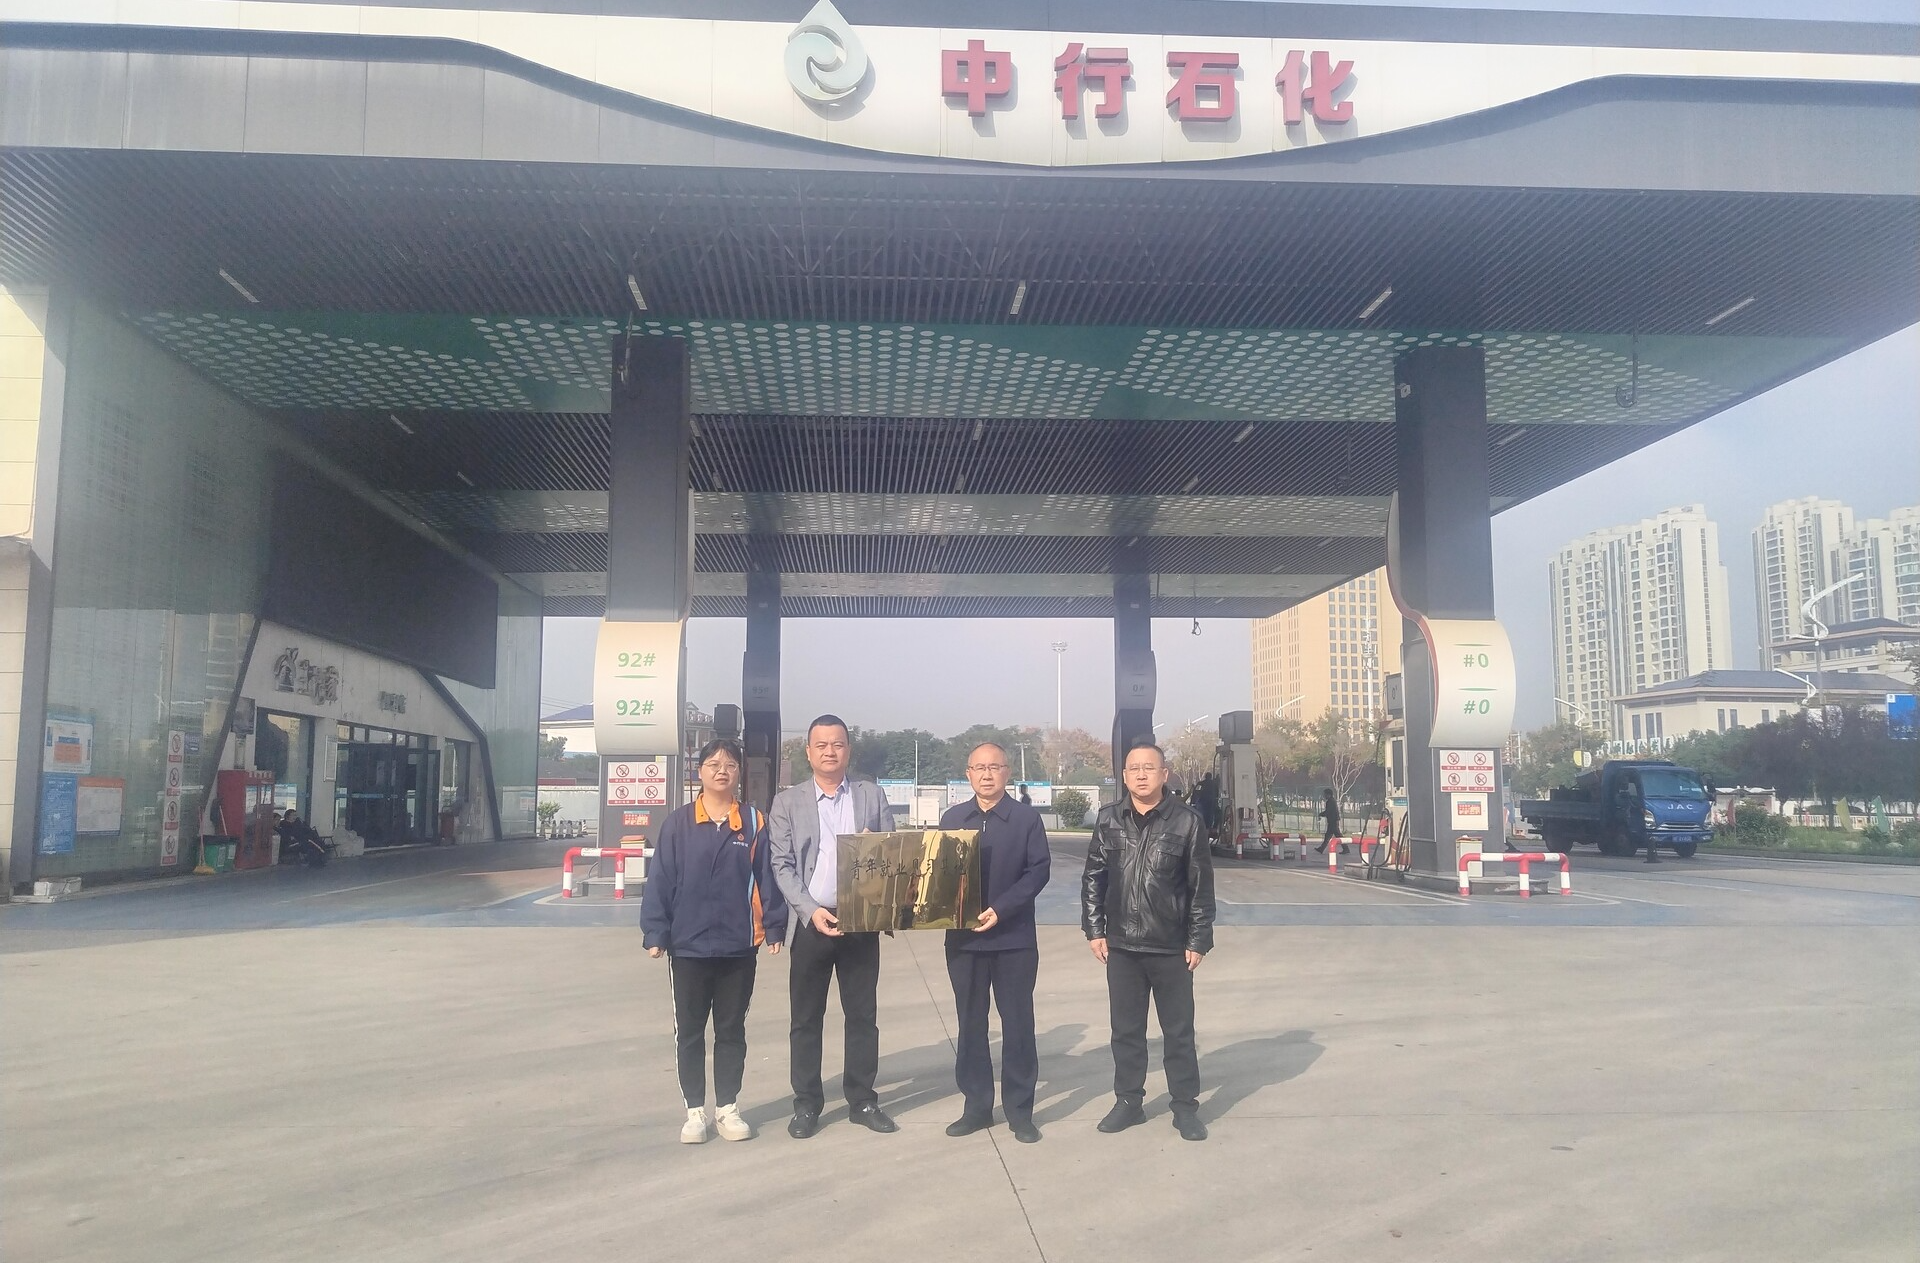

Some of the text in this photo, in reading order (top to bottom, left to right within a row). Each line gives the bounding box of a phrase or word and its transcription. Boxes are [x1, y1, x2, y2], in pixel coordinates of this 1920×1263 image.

[941, 39, 1354, 125] 中行石化
[617, 652, 656, 668] 92#
[616, 699, 655, 716] 92#
